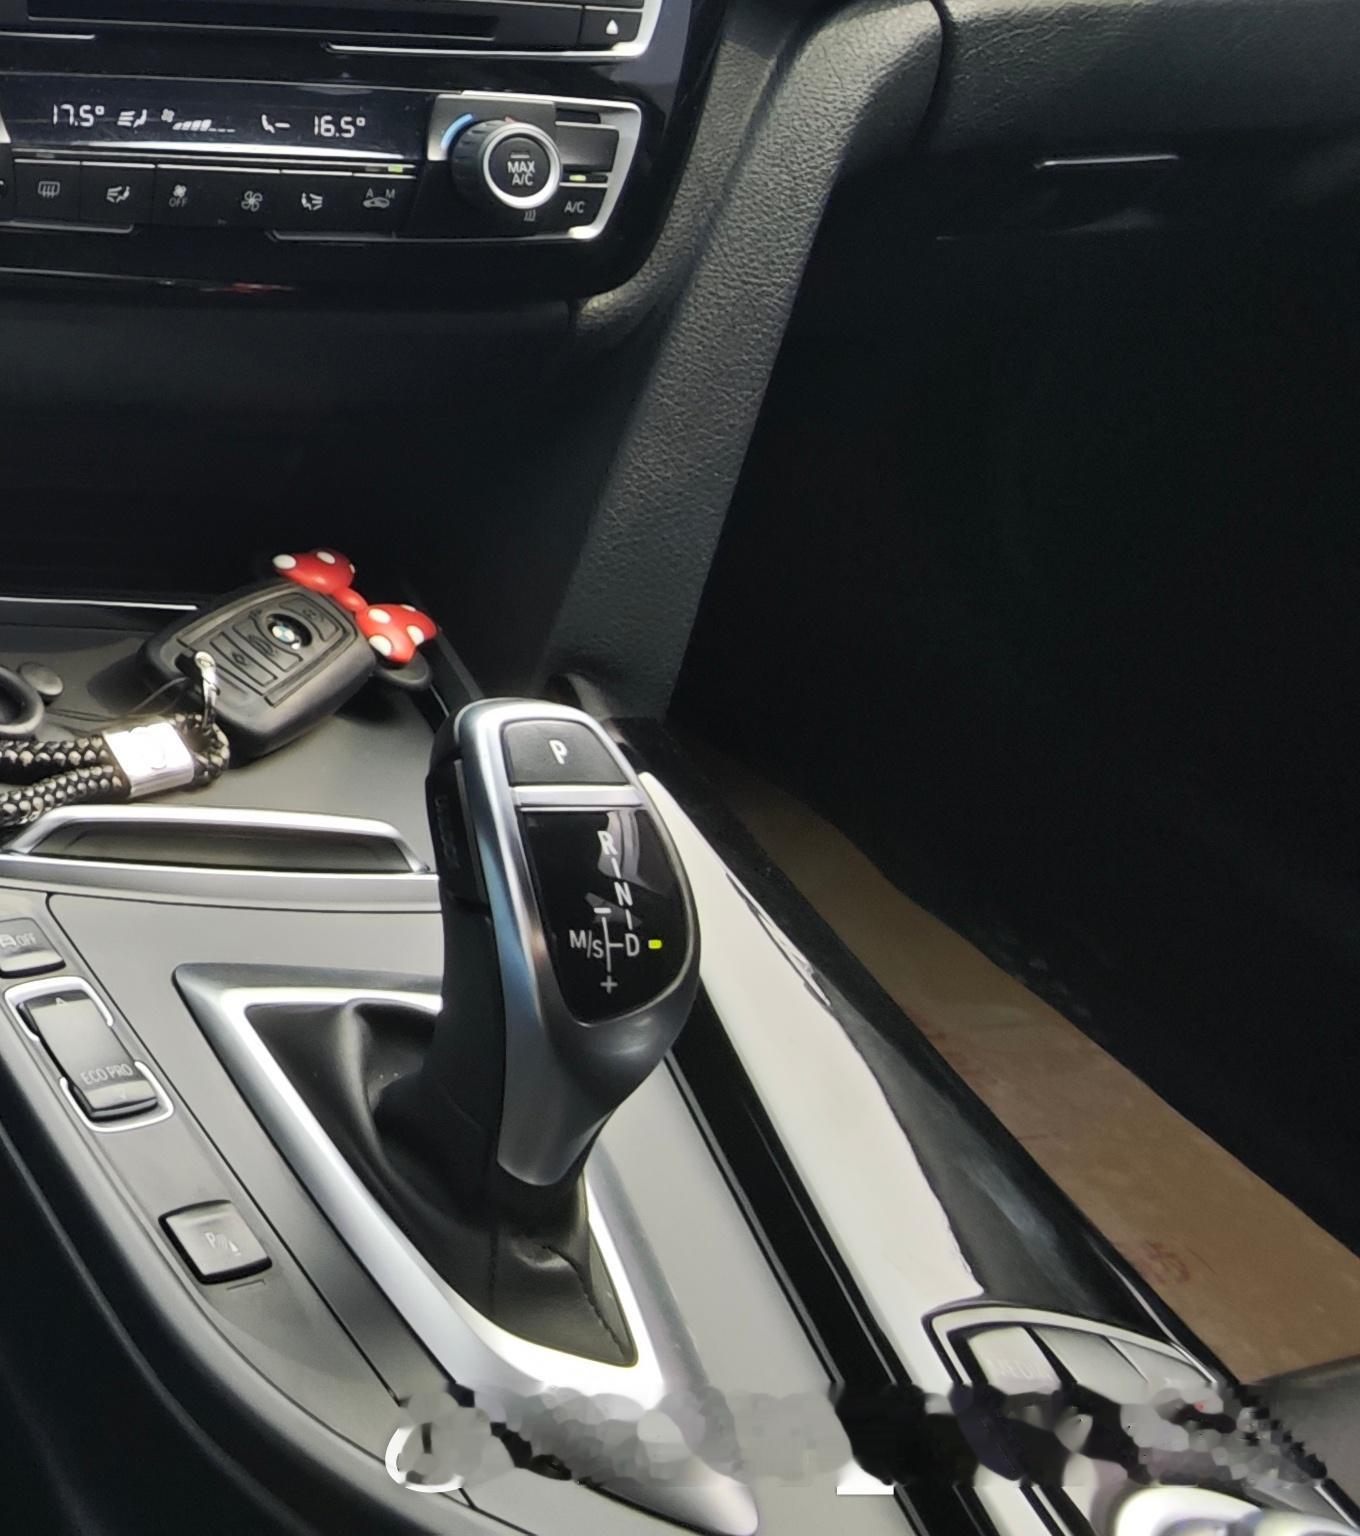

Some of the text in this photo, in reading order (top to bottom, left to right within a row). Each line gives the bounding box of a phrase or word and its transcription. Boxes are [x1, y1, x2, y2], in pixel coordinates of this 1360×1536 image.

[507, 160, 535, 174] MAX
[511, 173, 534, 187] A/C
[168, 197, 188, 208] OFF
[564, 200, 585, 214] A/C
[549, 739, 567, 765] P
[597, 830, 617, 856] R
[614, 882, 633, 907] N
[16, 932, 37, 947] OFF
[569, 929, 604, 959] M/S
[624, 933, 640, 957] D
[79, 1062, 134, 1086] ECO PRO
